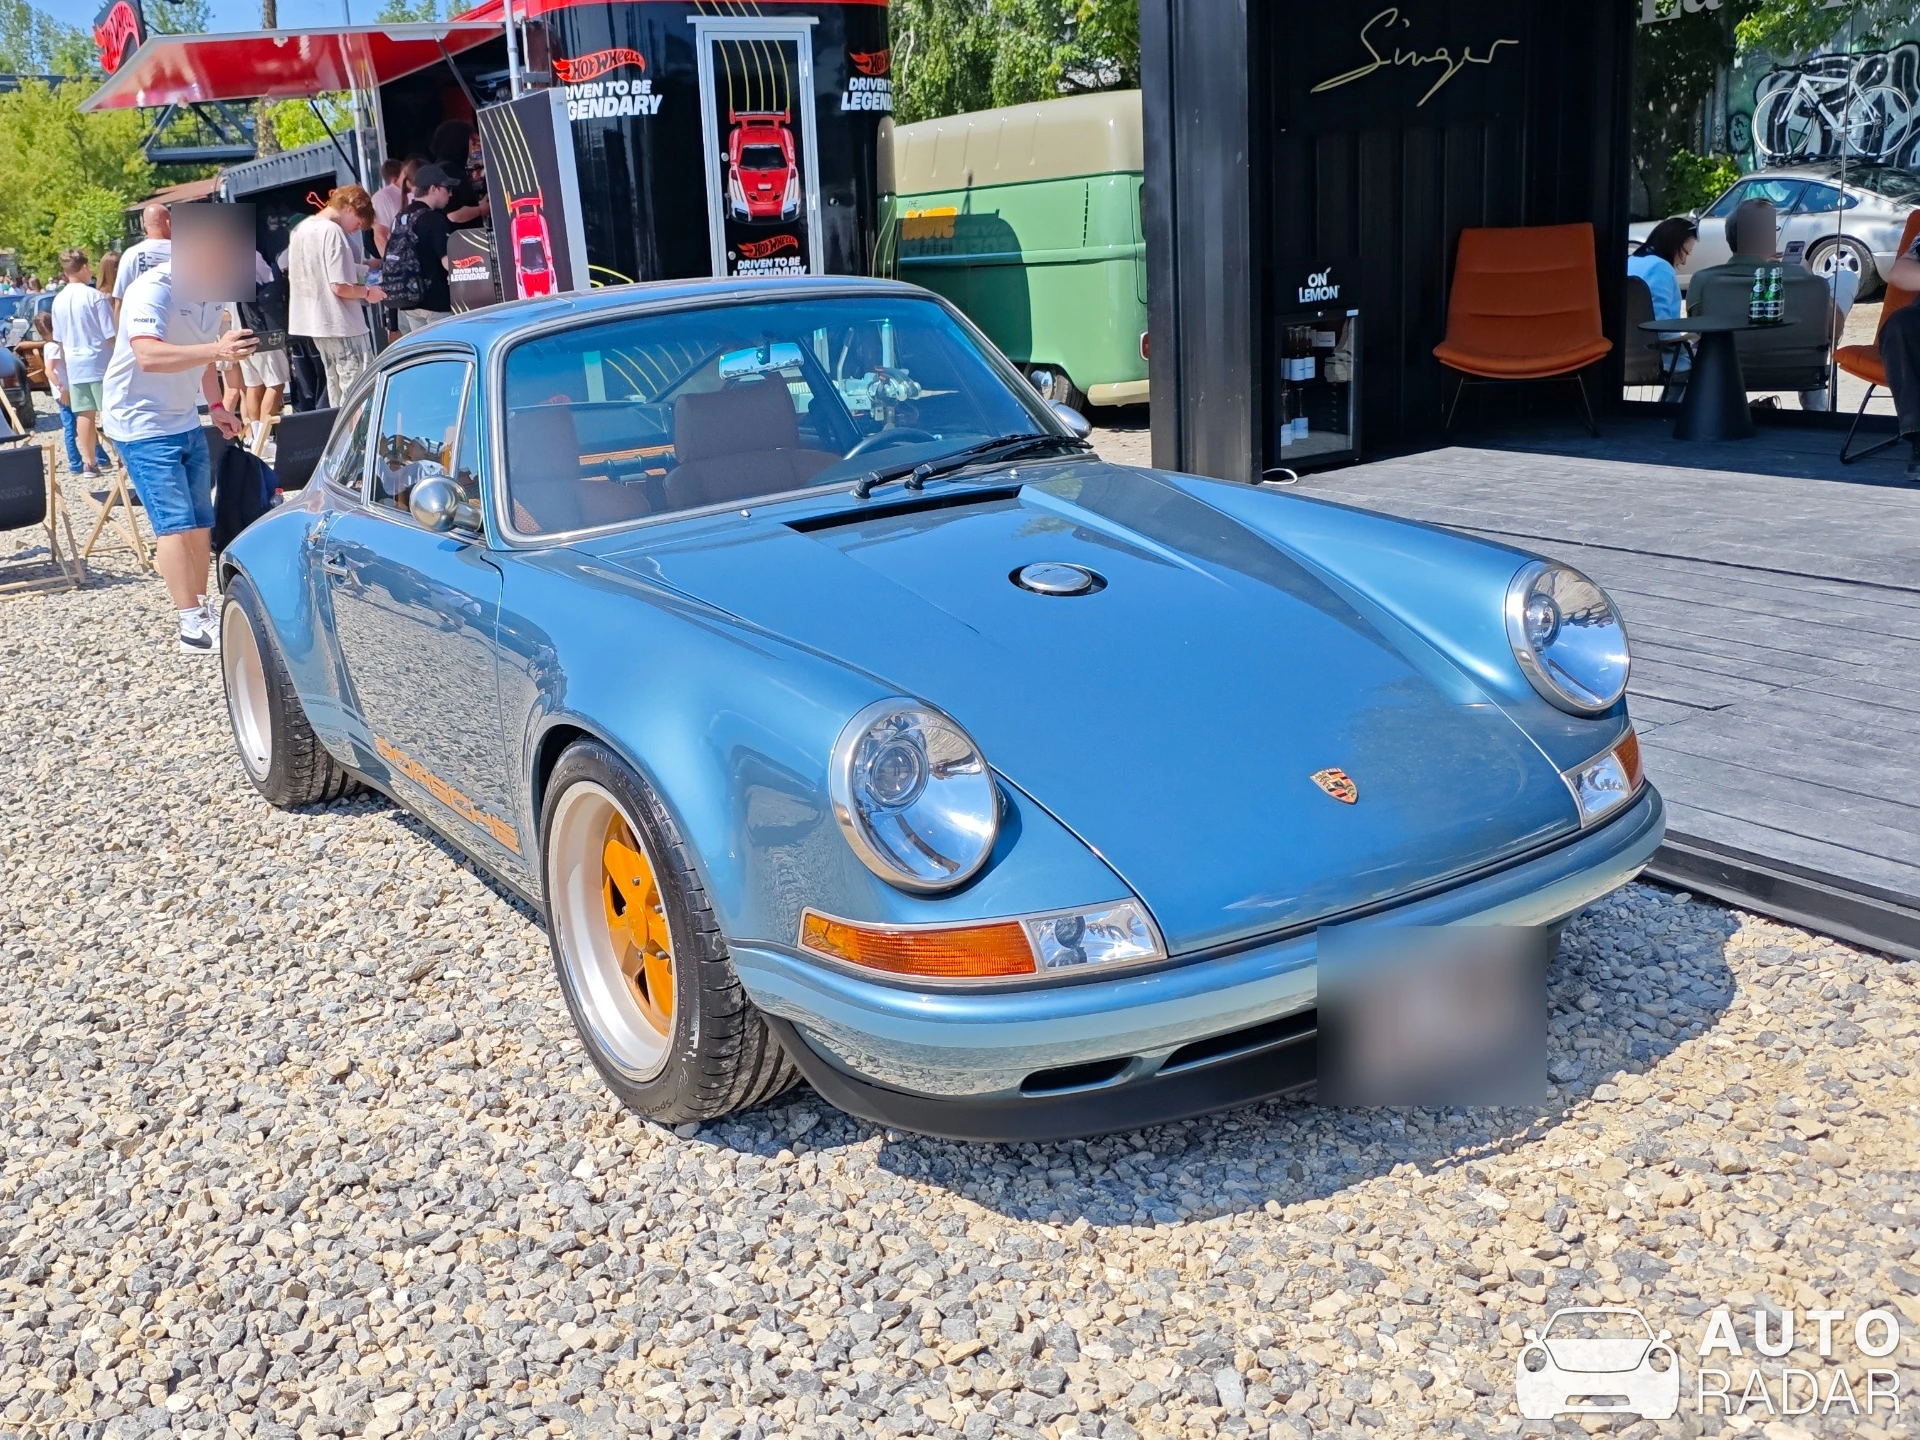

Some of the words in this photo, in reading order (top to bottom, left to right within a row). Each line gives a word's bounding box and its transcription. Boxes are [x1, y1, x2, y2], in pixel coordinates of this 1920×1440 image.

[1310, 7, 1519, 107] Singer
[565, 82, 604, 100] RIVEN
[605, 80, 629, 96] TO
[631, 79, 652, 95] BE
[848, 77, 886, 91] DRIVEN
[567, 94, 663, 121] GENDARY
[840, 91, 893, 111] LEGEND
[737, 257, 774, 270] DRIVEN
[774, 256, 788, 267] TO
[788, 255, 801, 266] BE
[451, 272, 490, 282] LEGENDARY
[1308, 271, 1328, 288] ON
[1299, 285, 1339, 303] LEMON
